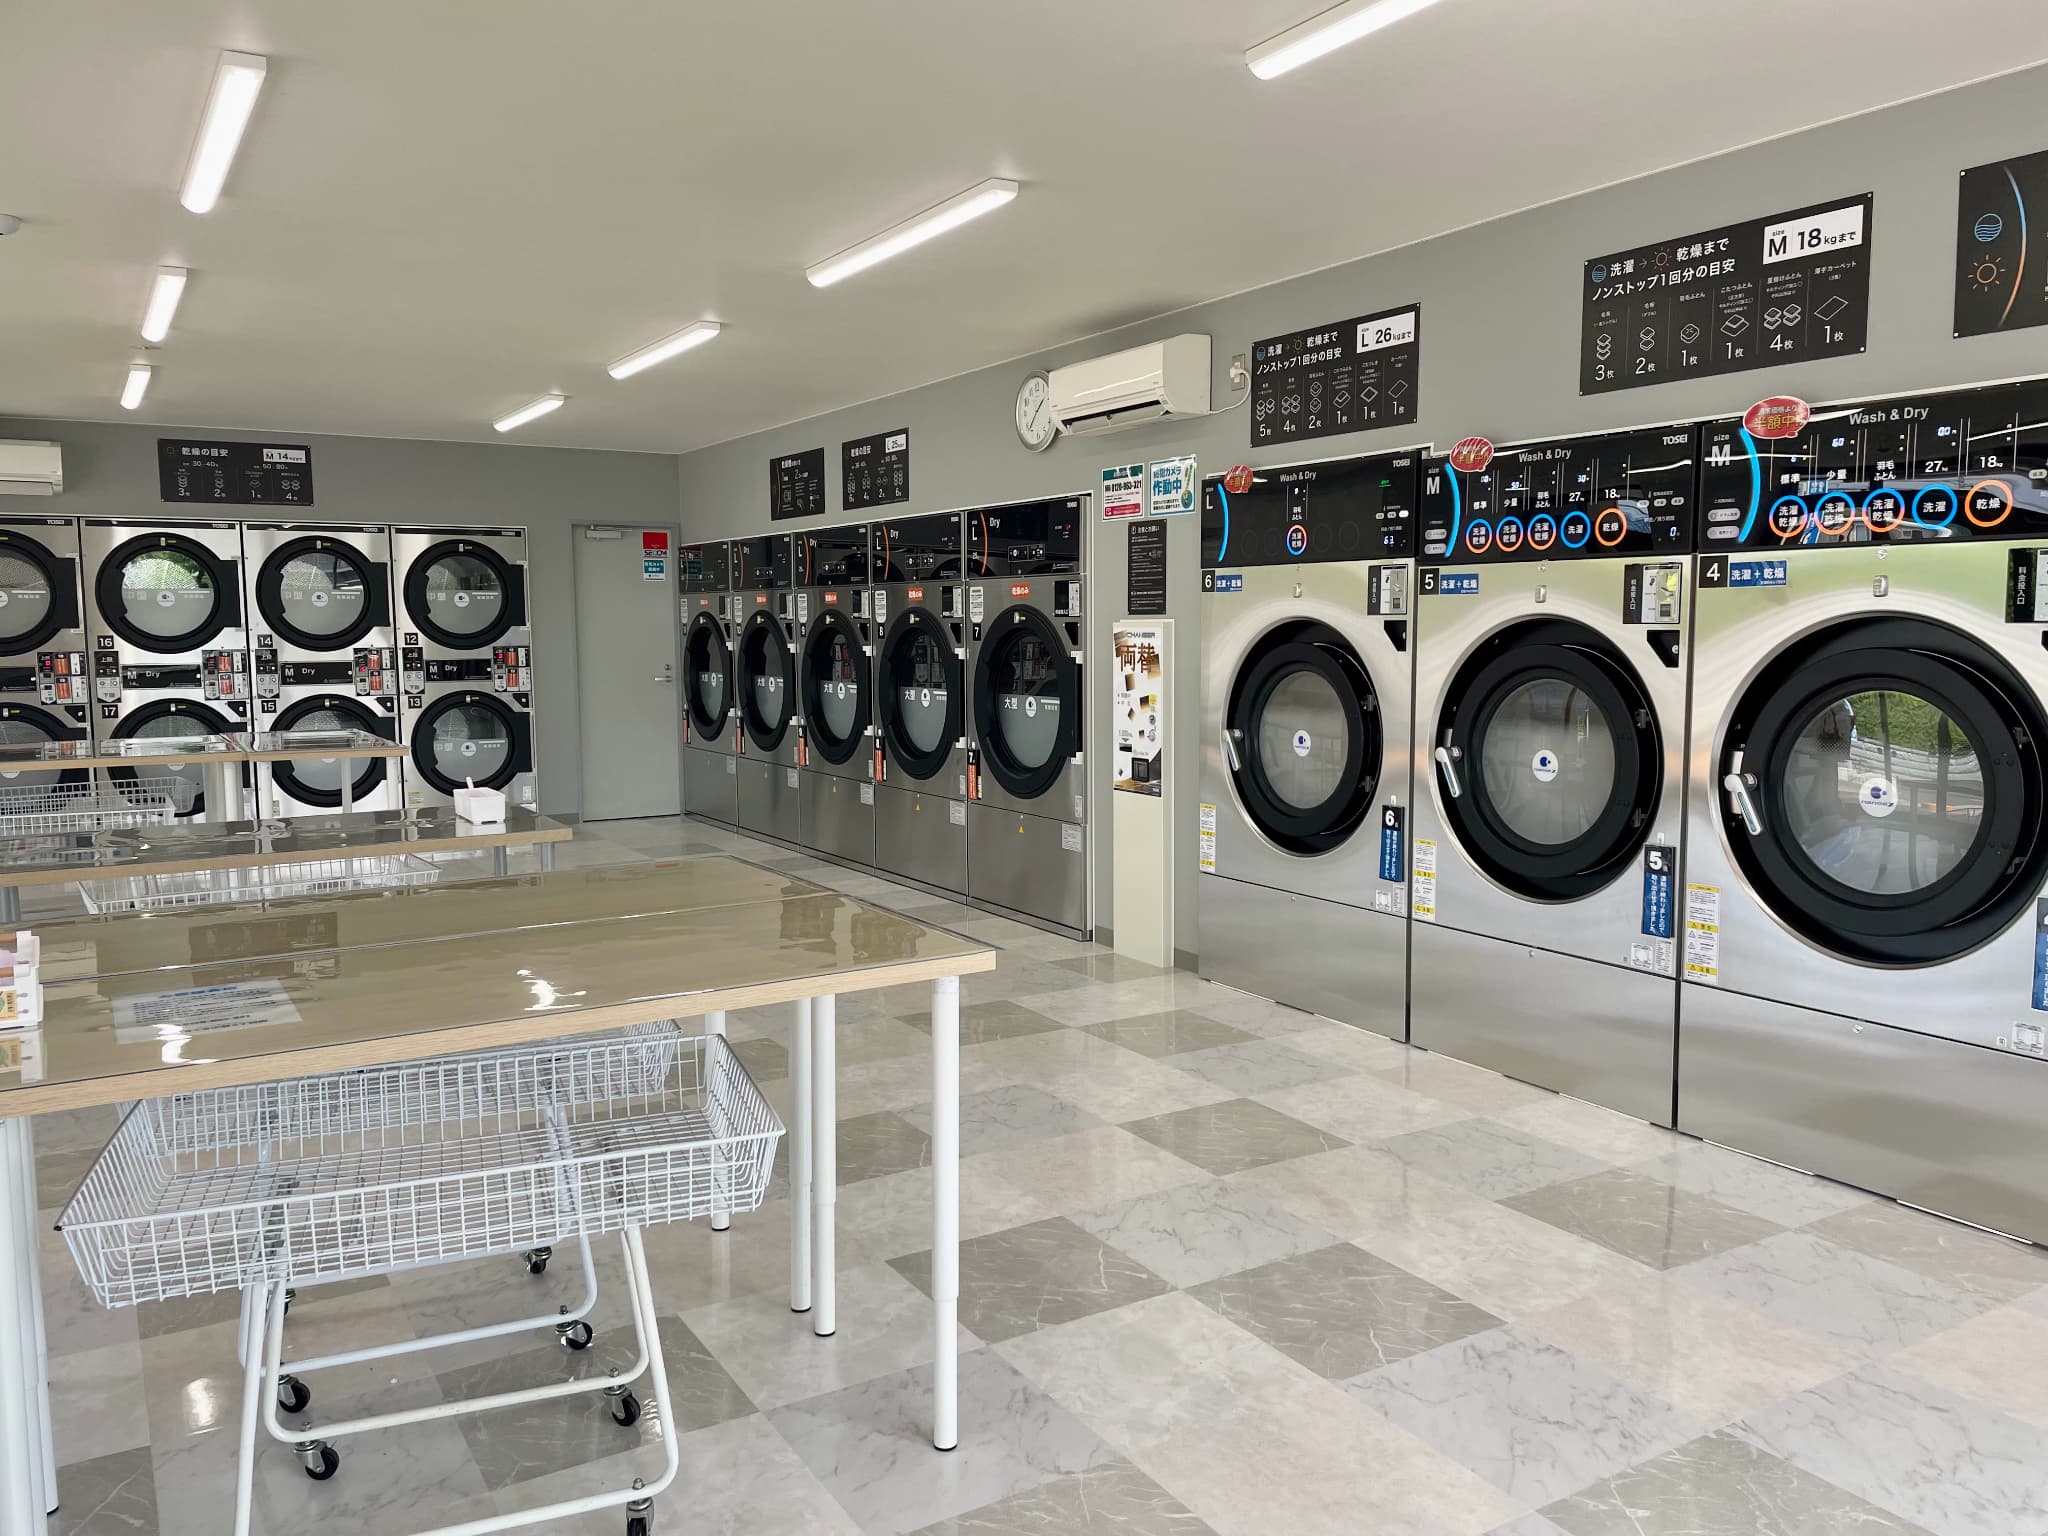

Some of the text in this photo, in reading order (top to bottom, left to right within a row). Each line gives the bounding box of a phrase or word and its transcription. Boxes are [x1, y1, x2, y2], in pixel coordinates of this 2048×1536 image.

[1768, 235, 1788, 257] M
[1610, 238, 1730, 277] 洗濯 乾燥まで
[1592, 258, 1736, 301] ノンストップ1回分の目安
[1306, 331, 1338, 348] 乾燥まで
[1361, 333, 1369, 348] L
[1256, 347, 1342, 375] ノンストップ1回分の目安
[1849, 407, 1929, 425] Wash & Dry
[1662, 433, 1688, 446] TOSEI
[1713, 433, 1730, 442] size
[1518, 448, 1572, 463] Wash & Dry
[1711, 444, 1731, 467] M
[1876, 460, 1895, 470] 羽毛
[1280, 472, 1299, 482] Wash
[1304, 471, 1317, 480] Dry
[1780, 473, 1800, 485] 標準
[1826, 469, 1847, 481] 少量
[1873, 471, 1897, 481] ふとん
[1152, 478, 1182, 497] 作動中
[1426, 476, 1441, 496] M
[1206, 494, 1214, 510] L
[1824, 502, 1846, 513] 洗濯
[1872, 499, 1895, 510] 洗濯
[1922, 501, 1947, 513] 洗濯
[1976, 498, 2001, 510] 乾燥
[1778, 505, 1799, 516] 洗濯
[1872, 511, 1894, 522] 乾燥
[989, 517, 1001, 528] Dry
[1778, 516, 1799, 528] 乾燥
[890, 529, 899, 540] Dry
[972, 526, 978, 541] L
[1669, 526, 1677, 537] 0
[876, 537, 881, 550] L
[1706, 562, 1721, 582] 4
[1204, 574, 1212, 588] 6
[1424, 573, 1434, 590] 5
[974, 626, 980, 638] 7
[99, 638, 113, 647] 16
[259, 636, 272, 645] 14
[405, 635, 417, 644] 12
[1120, 642, 1156, 674] 両替
[285, 667, 315, 676] M Dry
[429, 664, 458, 673] M Dry
[127, 670, 160, 680] M Dry
[904, 689, 916, 701] 大型
[262, 702, 275, 711] 15
[409, 698, 421, 707] 13
[1004, 697, 1019, 710] 大型
[103, 707, 116, 717] 17
[1385, 809, 1395, 827] 6
[1649, 850, 1663, 871] 5
